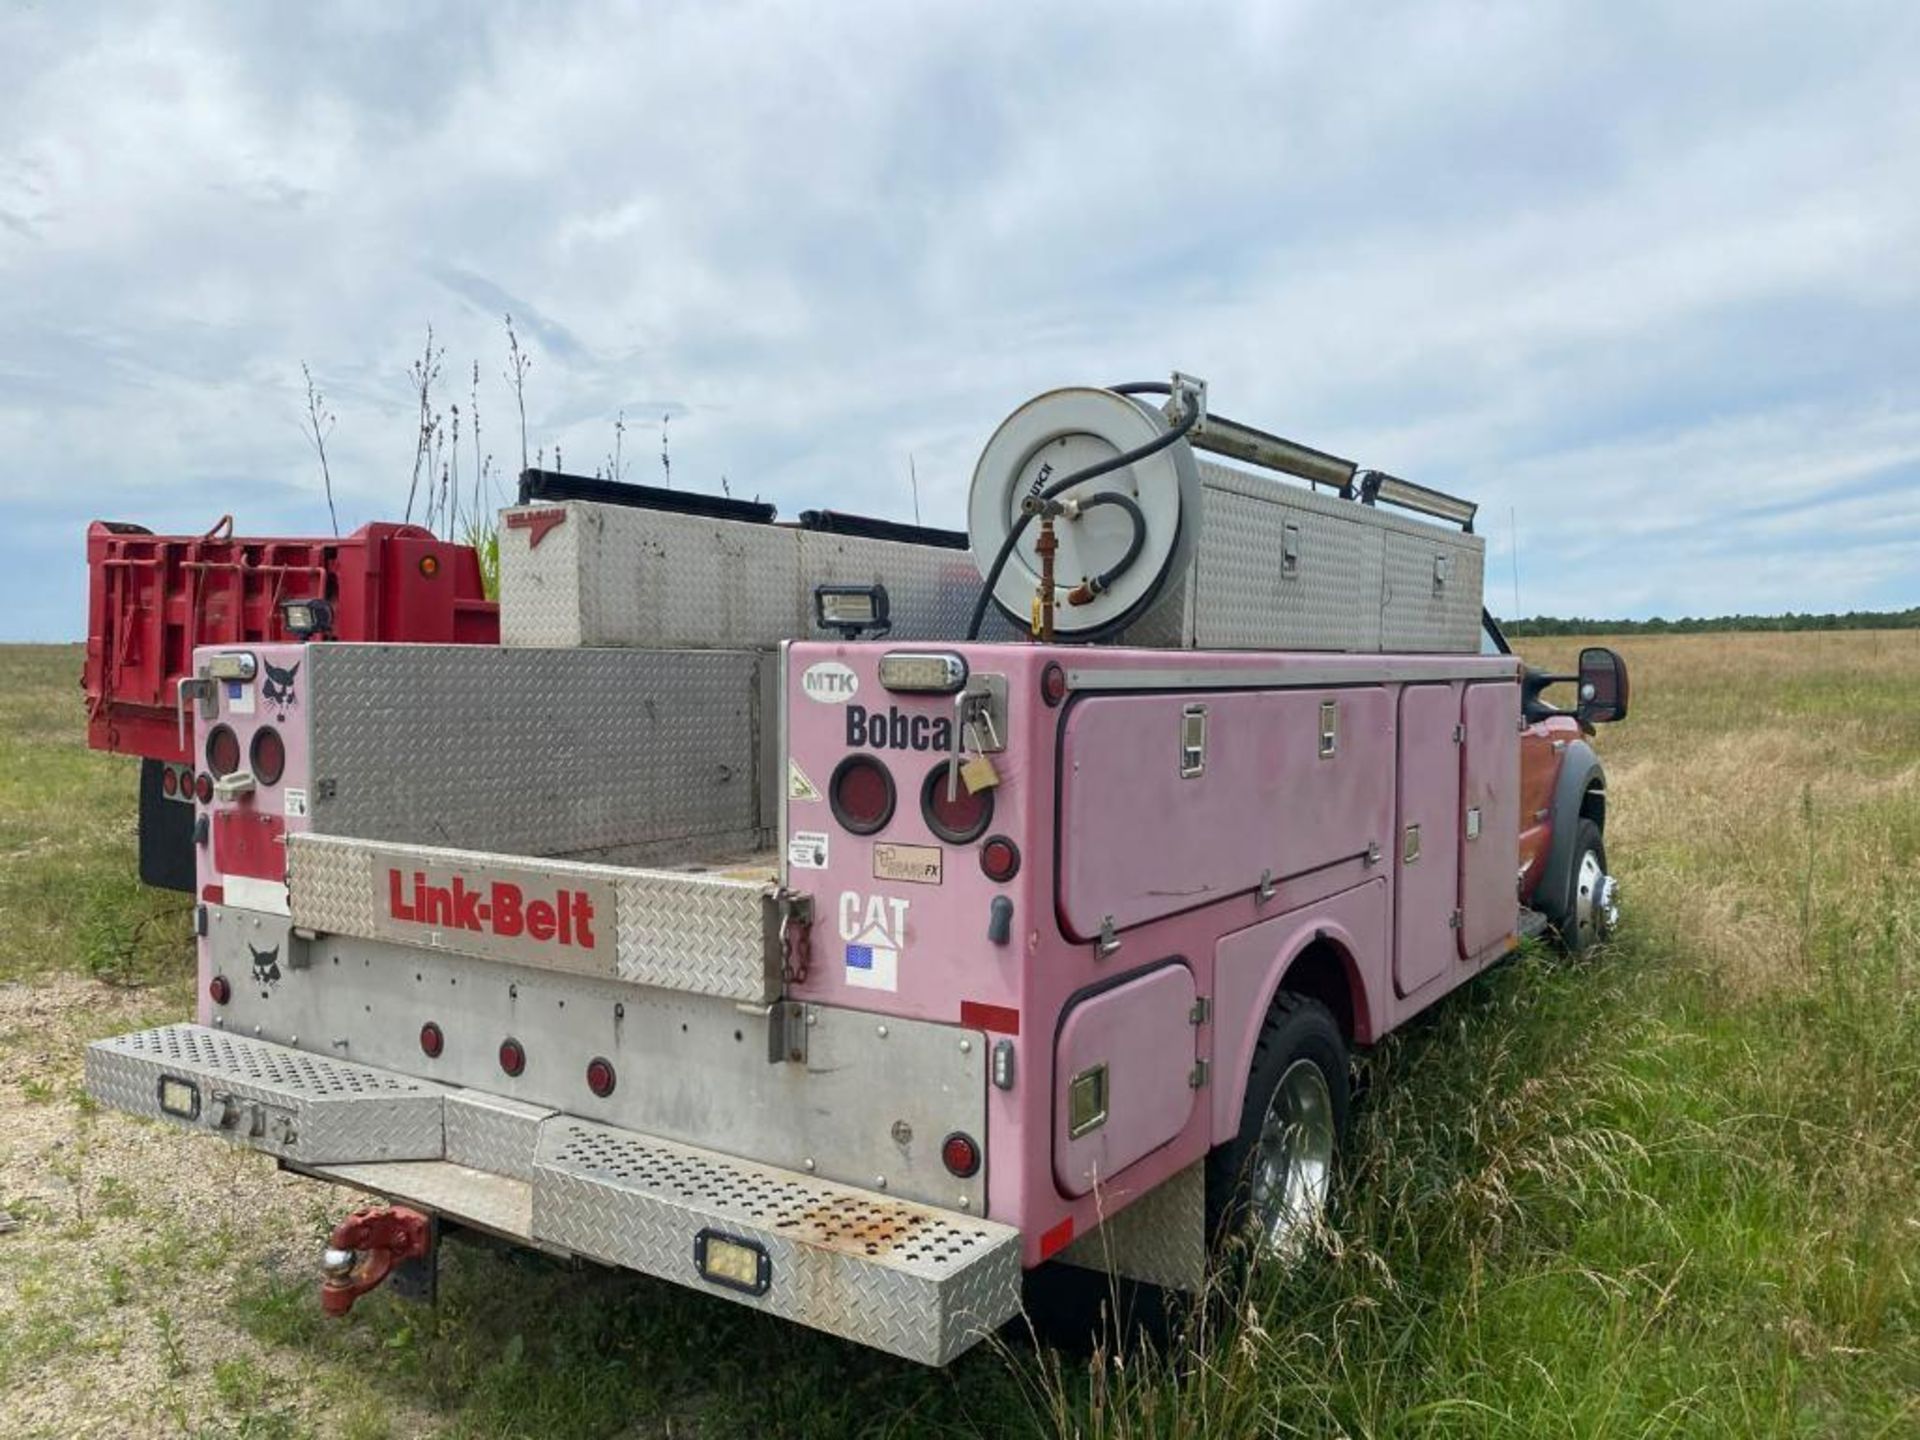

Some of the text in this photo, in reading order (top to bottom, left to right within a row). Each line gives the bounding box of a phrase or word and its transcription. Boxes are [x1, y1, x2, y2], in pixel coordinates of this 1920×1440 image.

[806, 672, 854, 692] MTK
[389, 868, 595, 949] Link-Belt
[839, 891, 909, 949] CAT
